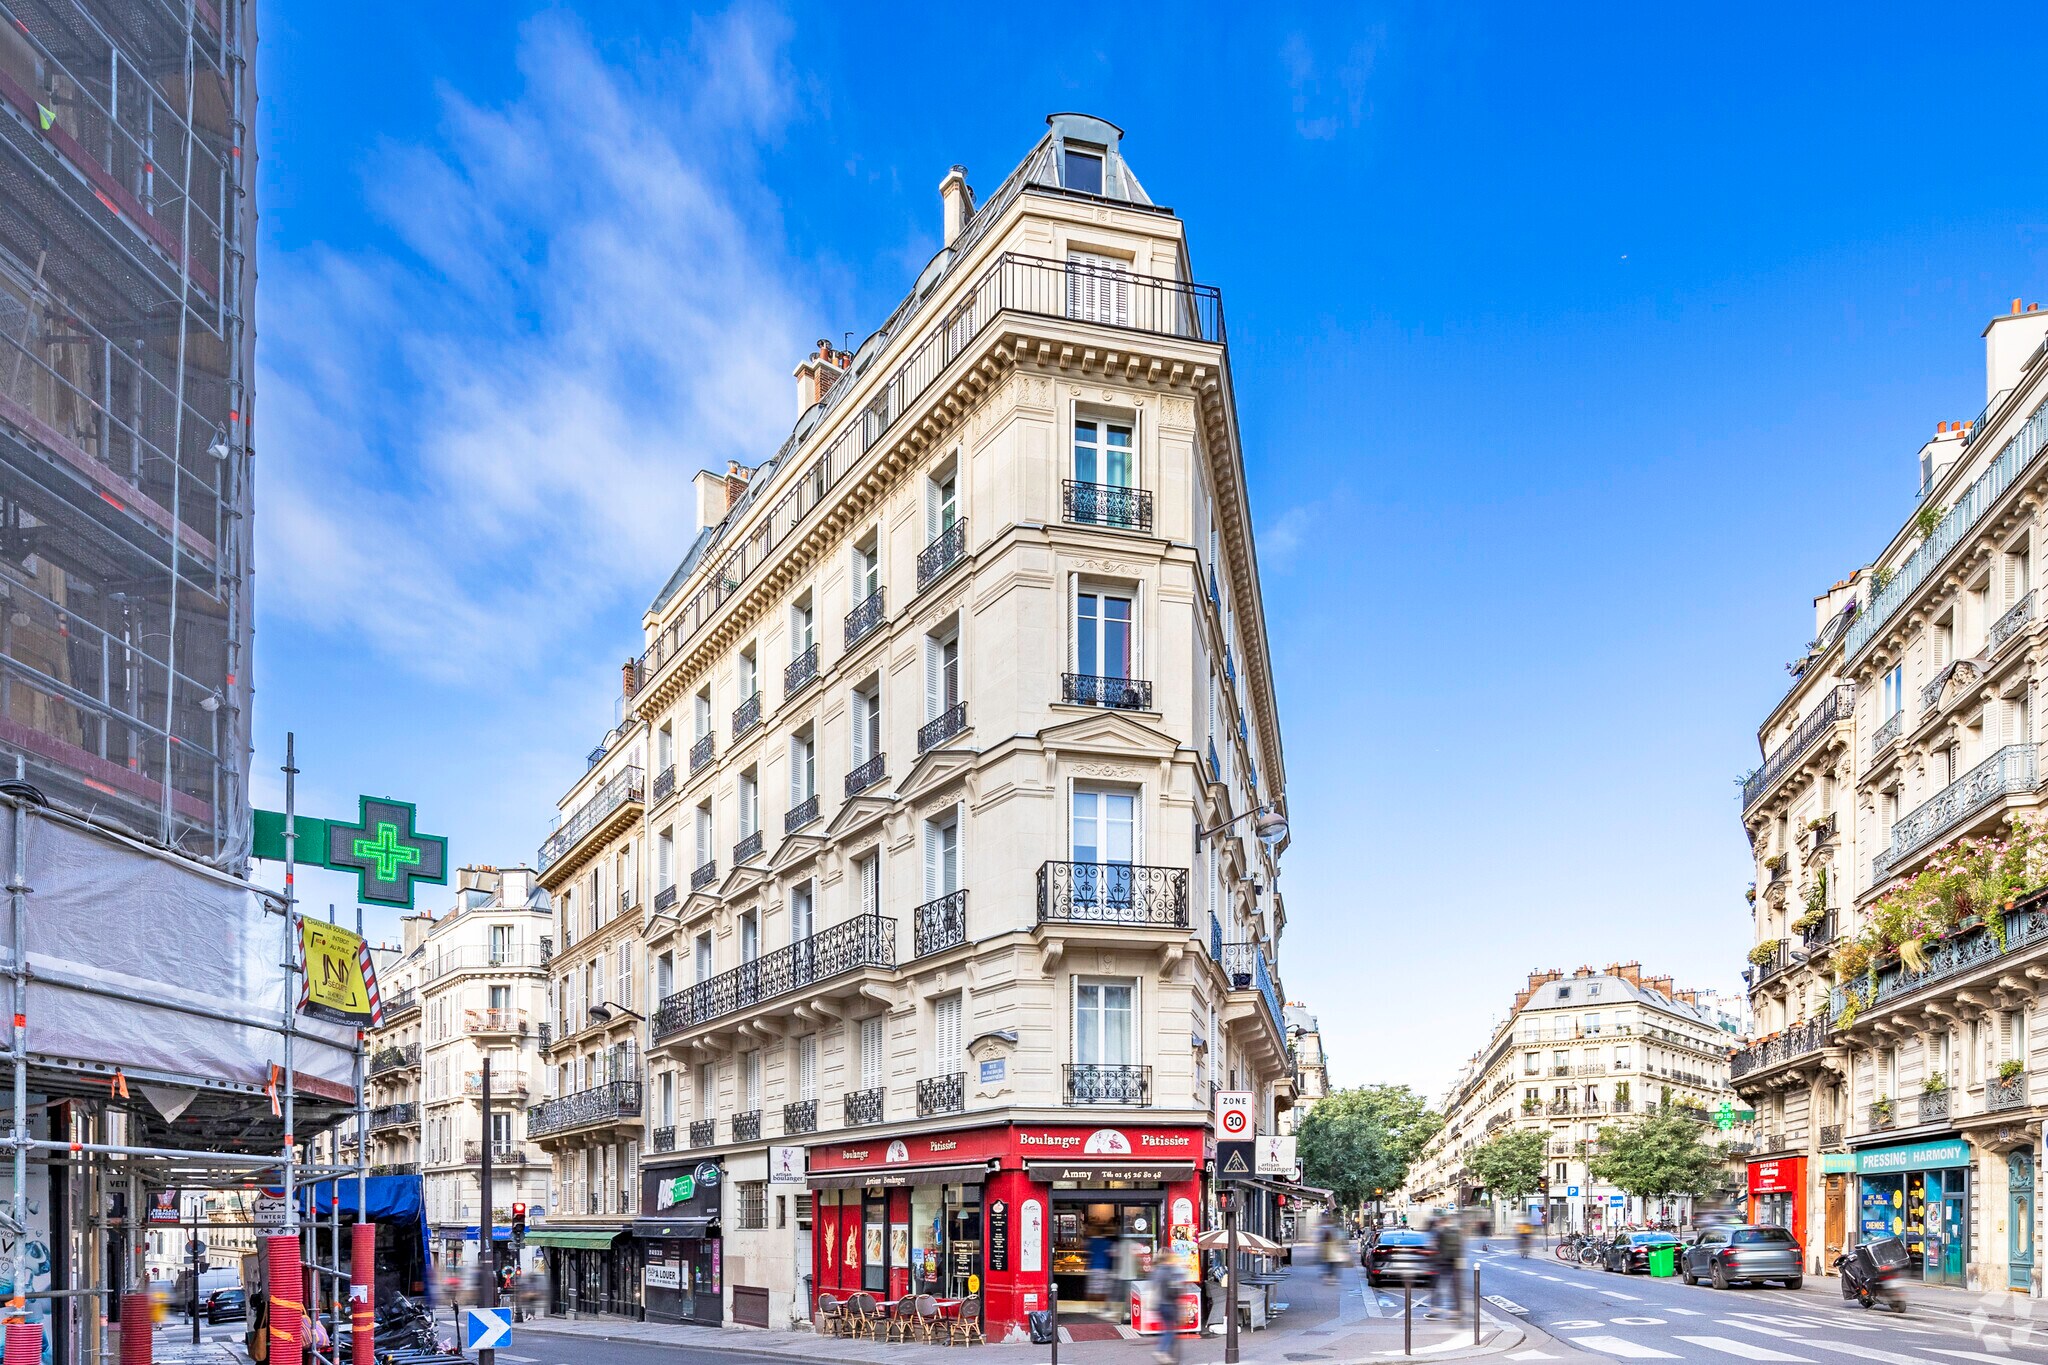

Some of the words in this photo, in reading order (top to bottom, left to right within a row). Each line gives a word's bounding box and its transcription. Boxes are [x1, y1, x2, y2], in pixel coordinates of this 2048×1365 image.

[1223, 1097, 1247, 1105] ZONE
[1228, 1116, 1242, 1127] 30
[1019, 1133, 1081, 1149] Boulanger
[1141, 1134, 1190, 1146] Pâtissier
[842, 1149, 869, 1161] Boulanger
[930, 1140, 957, 1151] Pâtissier
[1863, 1151, 1907, 1169] PRESSING
[1913, 1146, 1962, 1163] HARMONY
[1062, 1169, 1092, 1180] Ammy
[1123, 1172, 1132, 1180] 45
[1153, 1171, 1162, 1180] 48
[1257, 1165, 1293, 1174] boulanger
[772, 1174, 803, 1182] boulanger
[883, 1176, 906, 1186] Boulanger
[1865, 1221, 1885, 1230] CHEMISE
[0, 1230, 15, 1239] VICH
[660, 1270, 676, 1280] LOUER
[1550, 1316, 1668, 1330] 30
